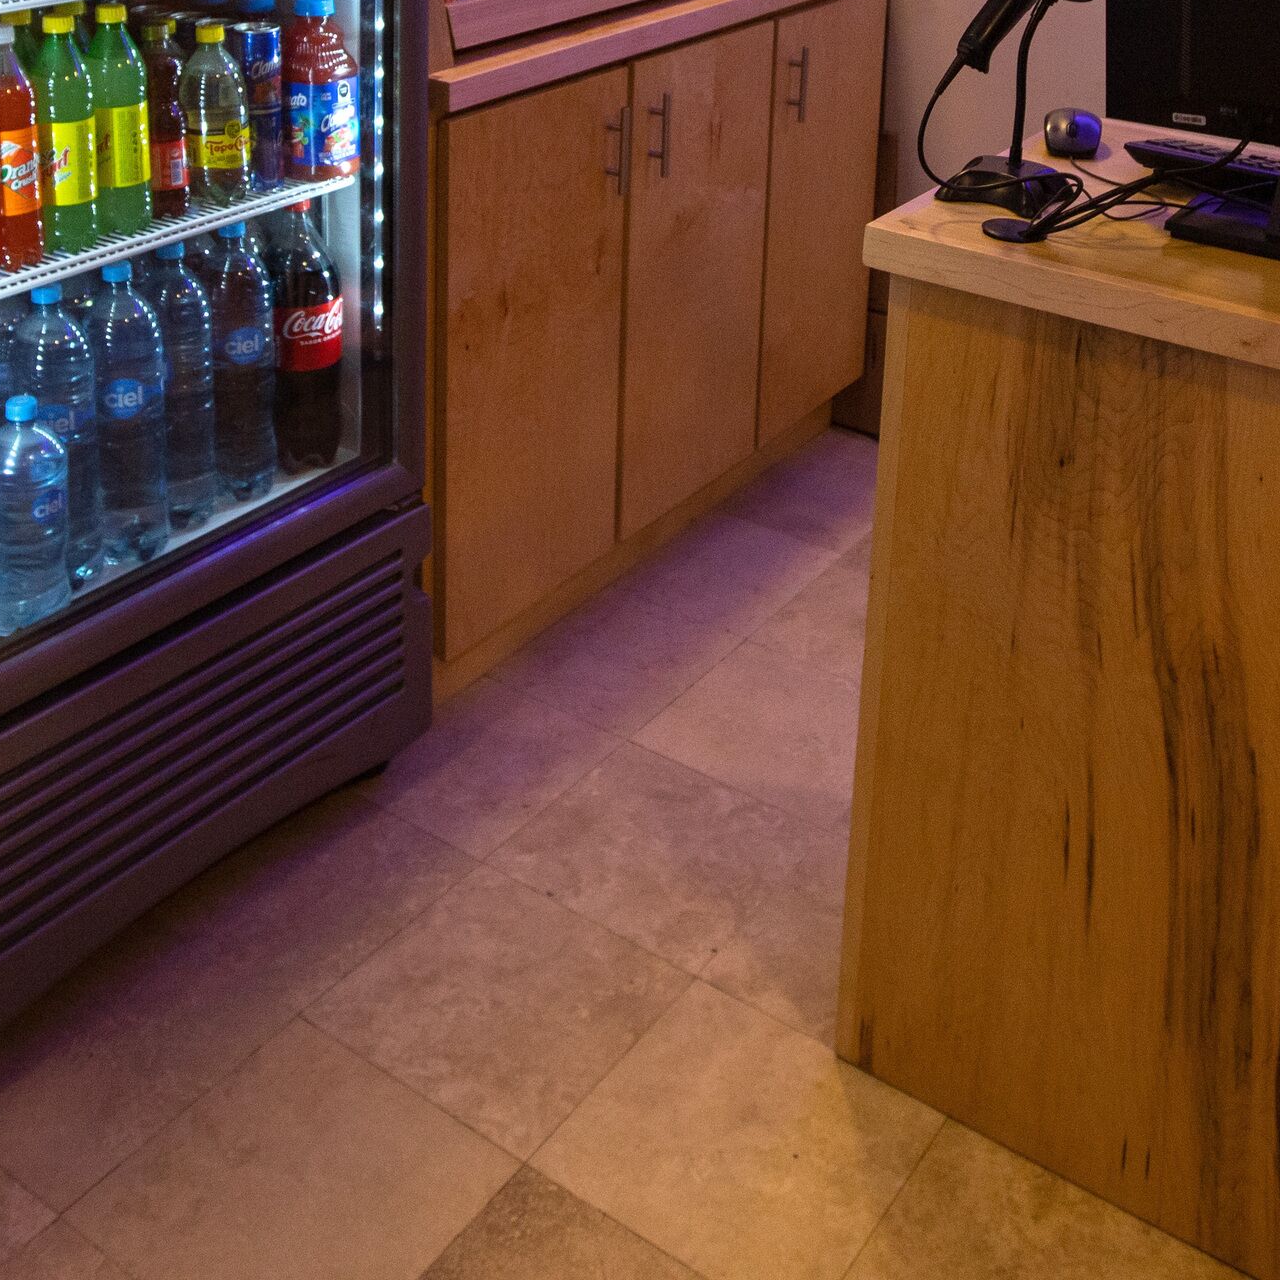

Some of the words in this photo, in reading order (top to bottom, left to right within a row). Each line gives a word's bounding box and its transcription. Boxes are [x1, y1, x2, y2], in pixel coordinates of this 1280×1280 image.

[224, 334, 260, 355] ciel
[104, 385, 144, 408] ciel
[34, 492, 62, 516] ciel
